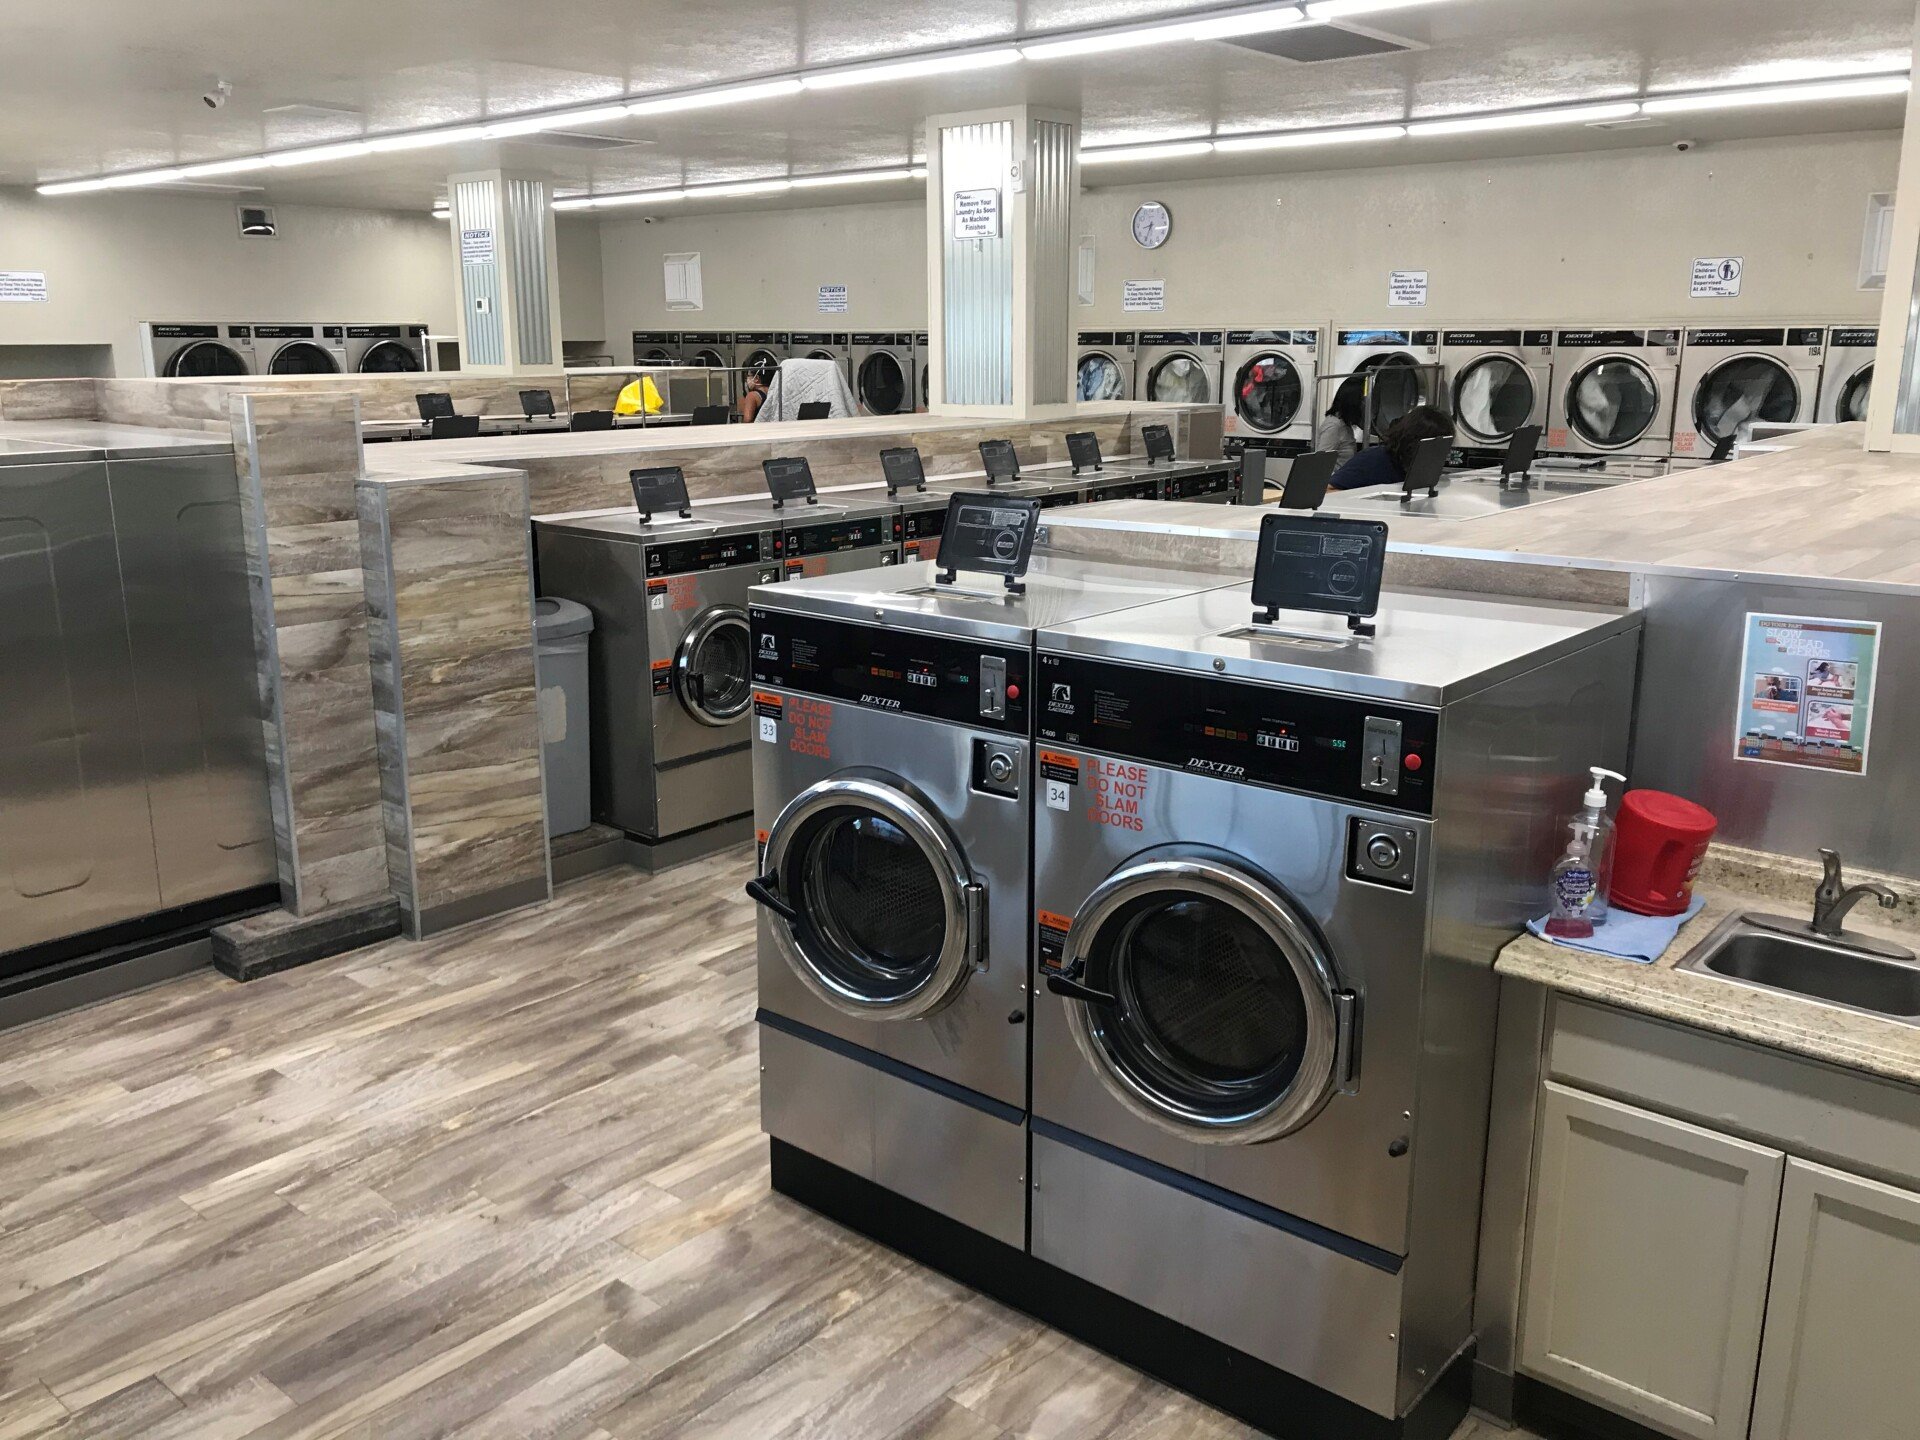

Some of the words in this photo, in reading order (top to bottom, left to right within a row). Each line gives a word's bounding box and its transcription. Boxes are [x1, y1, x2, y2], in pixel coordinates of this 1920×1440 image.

[464, 231, 490, 239] NOTICE
[1808, 347, 1821, 356] 119A
[1766, 628, 1803, 639] SLOW
[1776, 638, 1824, 649] SPREAD
[1787, 647, 1831, 658] GERMS
[788, 697, 833, 716] PLEASE
[860, 693, 901, 709] DEXTER
[1047, 700, 1075, 710] DEXTER
[788, 711, 805, 725] DO
[808, 716, 833, 730] NOT
[763, 723, 774, 736] 33
[794, 726, 827, 743] SLAM
[789, 739, 831, 759] DOORS
[1087, 758, 1148, 783] PLEASE
[1187, 757, 1246, 776] DEXTER
[1050, 788, 1066, 802] 34
[1087, 775, 1109, 792] DO
[1114, 781, 1147, 799] NOT
[1096, 793, 1138, 814] SLAM
[1087, 807, 1144, 832] DOORS
